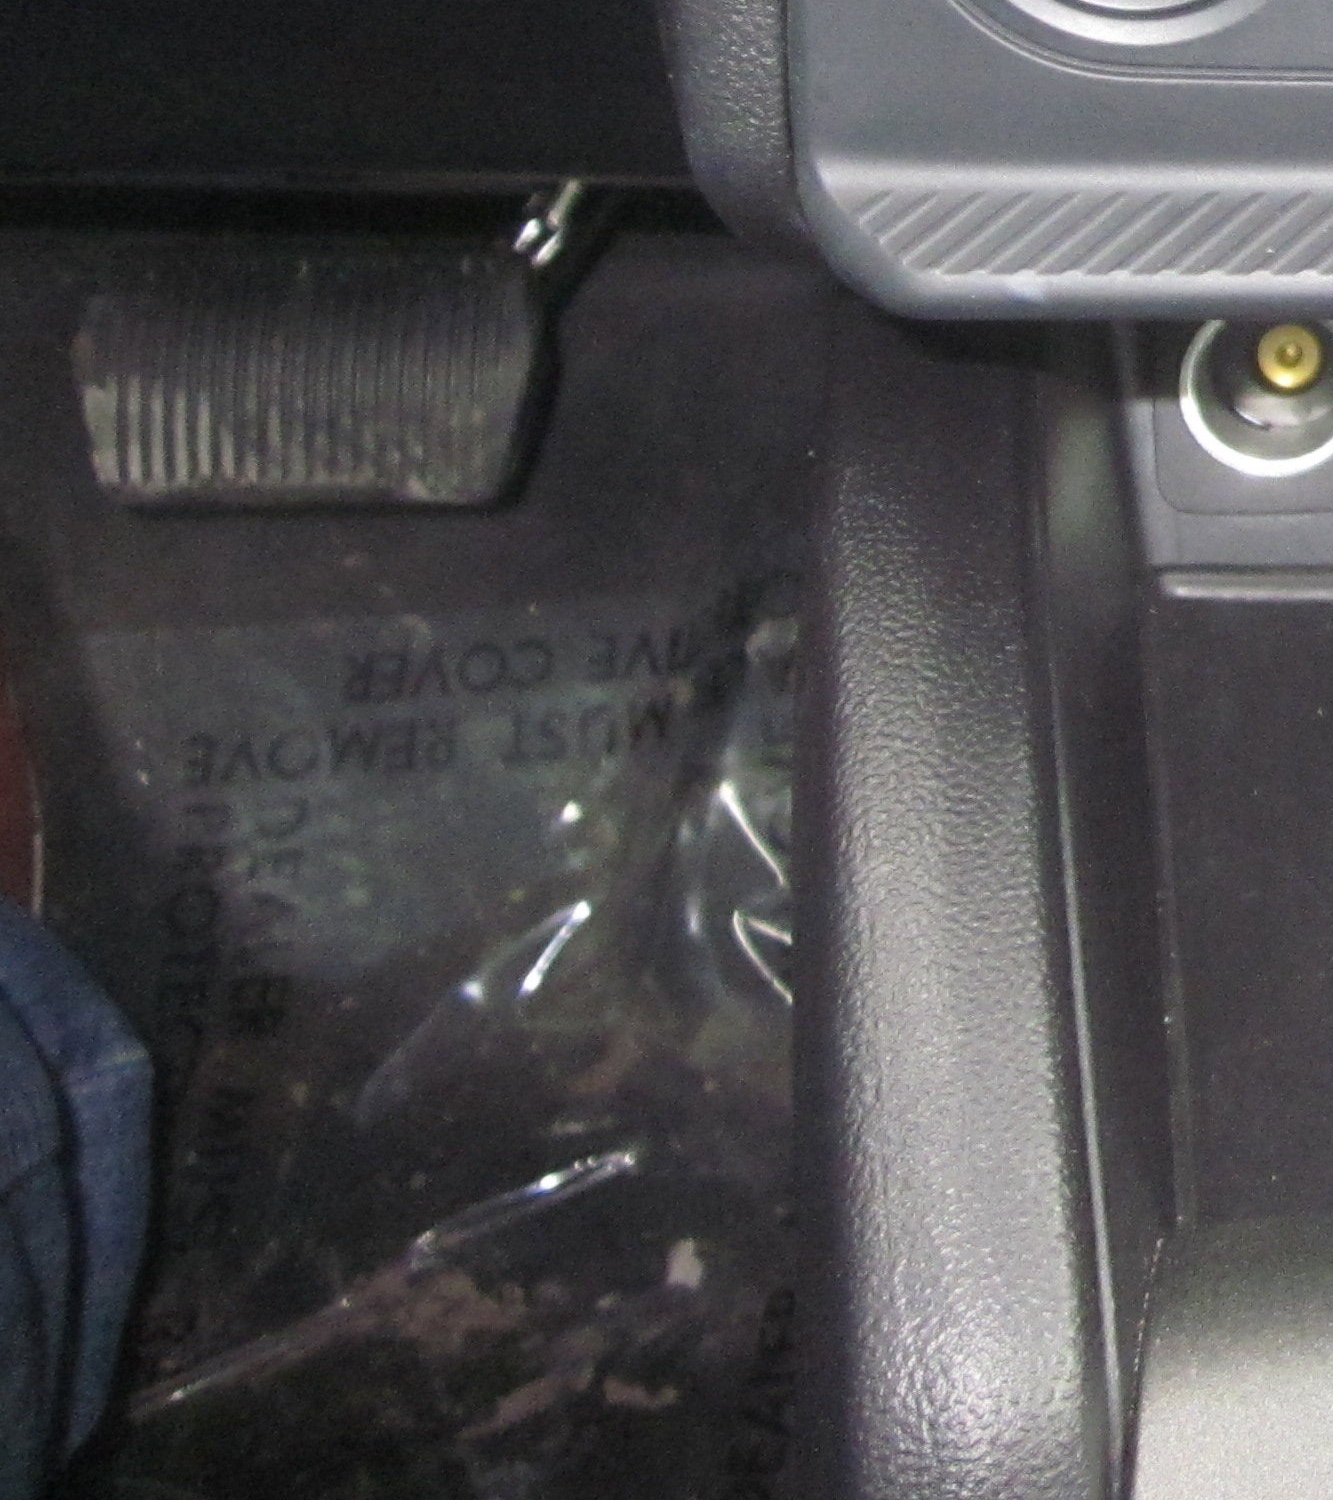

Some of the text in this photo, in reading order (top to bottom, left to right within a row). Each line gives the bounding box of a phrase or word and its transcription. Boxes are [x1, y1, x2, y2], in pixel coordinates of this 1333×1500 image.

[341, 638, 555, 703] COVER
[182, 710, 456, 789] REMOVE
[504, 698, 682, 770] MUST
